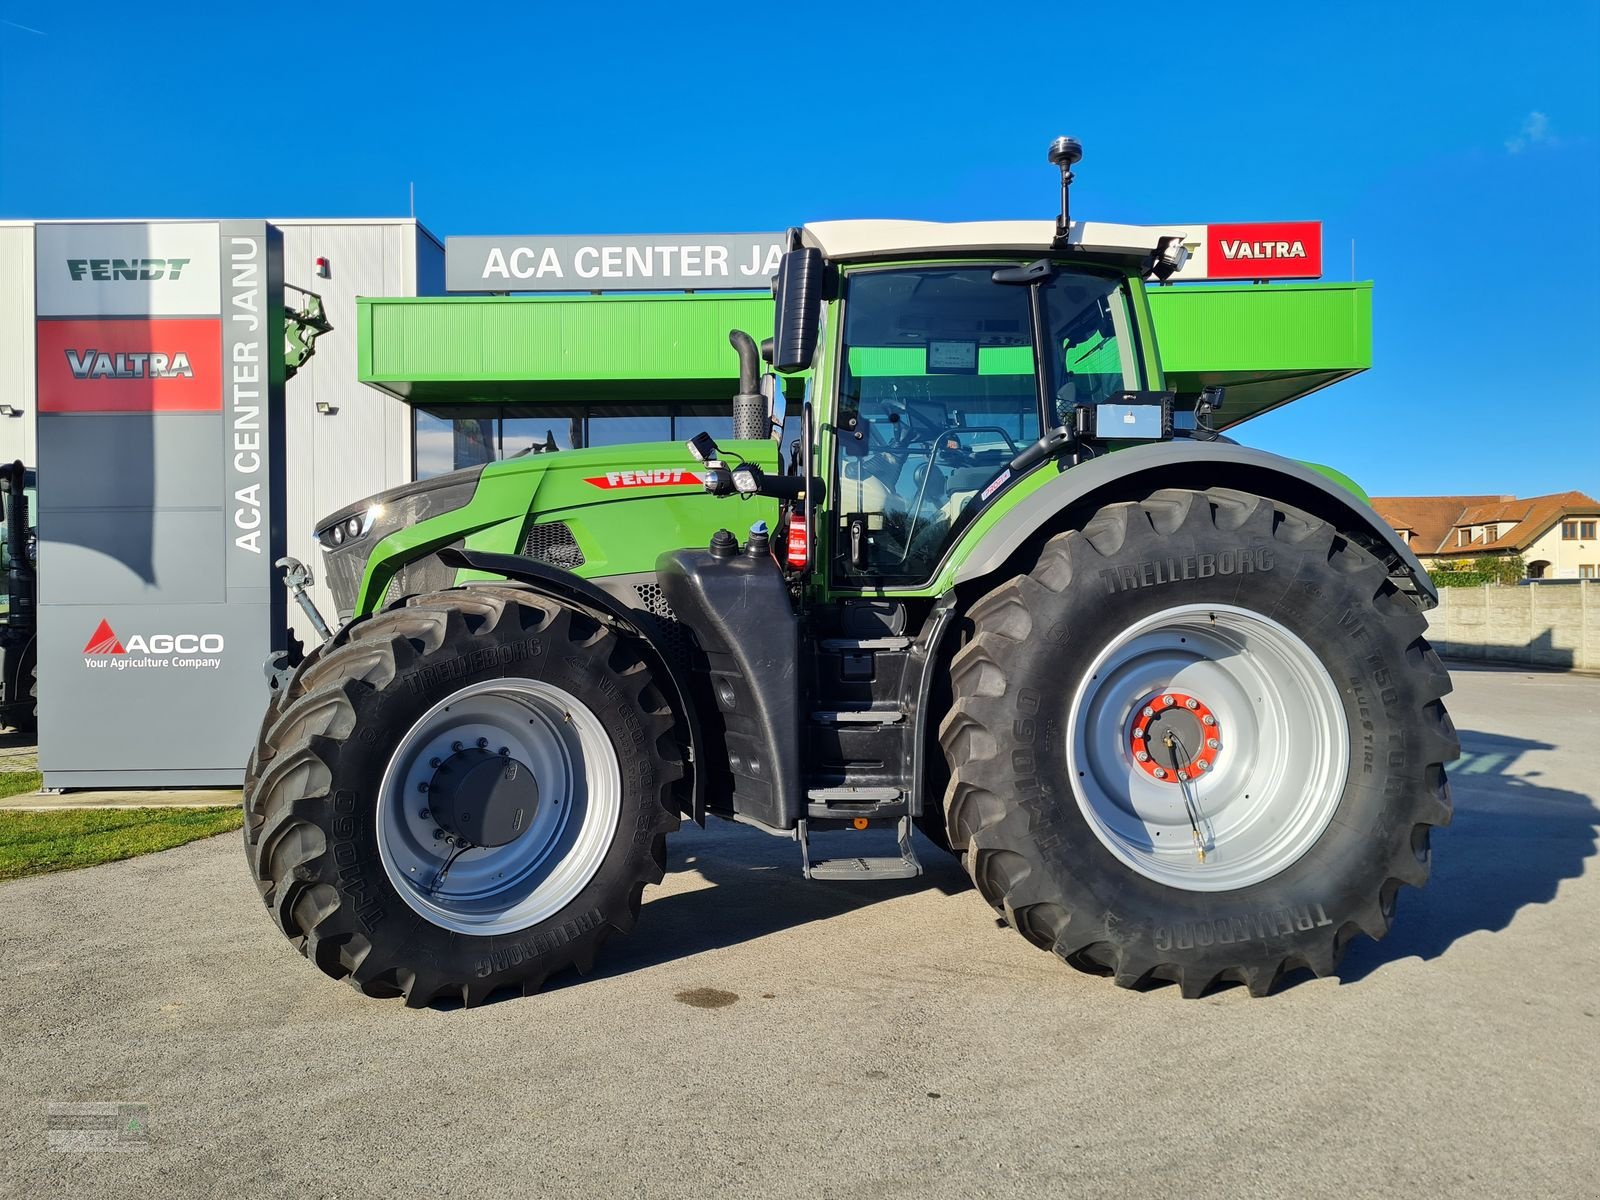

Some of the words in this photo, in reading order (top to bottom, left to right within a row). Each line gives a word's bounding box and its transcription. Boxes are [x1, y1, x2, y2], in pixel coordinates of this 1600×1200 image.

[67, 259, 191, 281] FENDT
[481, 247, 564, 278] ACA
[574, 245, 729, 278] CENTER
[1220, 240, 1307, 260] VALTRA
[231, 237, 258, 332] JANU
[64, 349, 194, 379] VALTRA
[233, 339, 260, 474] CENTER
[605, 468, 687, 487] FENDT
[235, 482, 261, 554] ACA
[1101, 546, 1276, 594] TRELLEBORG
[84, 657, 107, 668] Your
[111, 656, 168, 668] Agriculture
[172, 656, 221, 670] Company
[124, 633, 224, 653] AGCO
[402, 637, 543, 696] TRELLEBORG
[332, 789, 385, 934] TM1060
[474, 905, 607, 978] TRELLEBORG
[1154, 903, 1333, 952] TRELLEBORG
